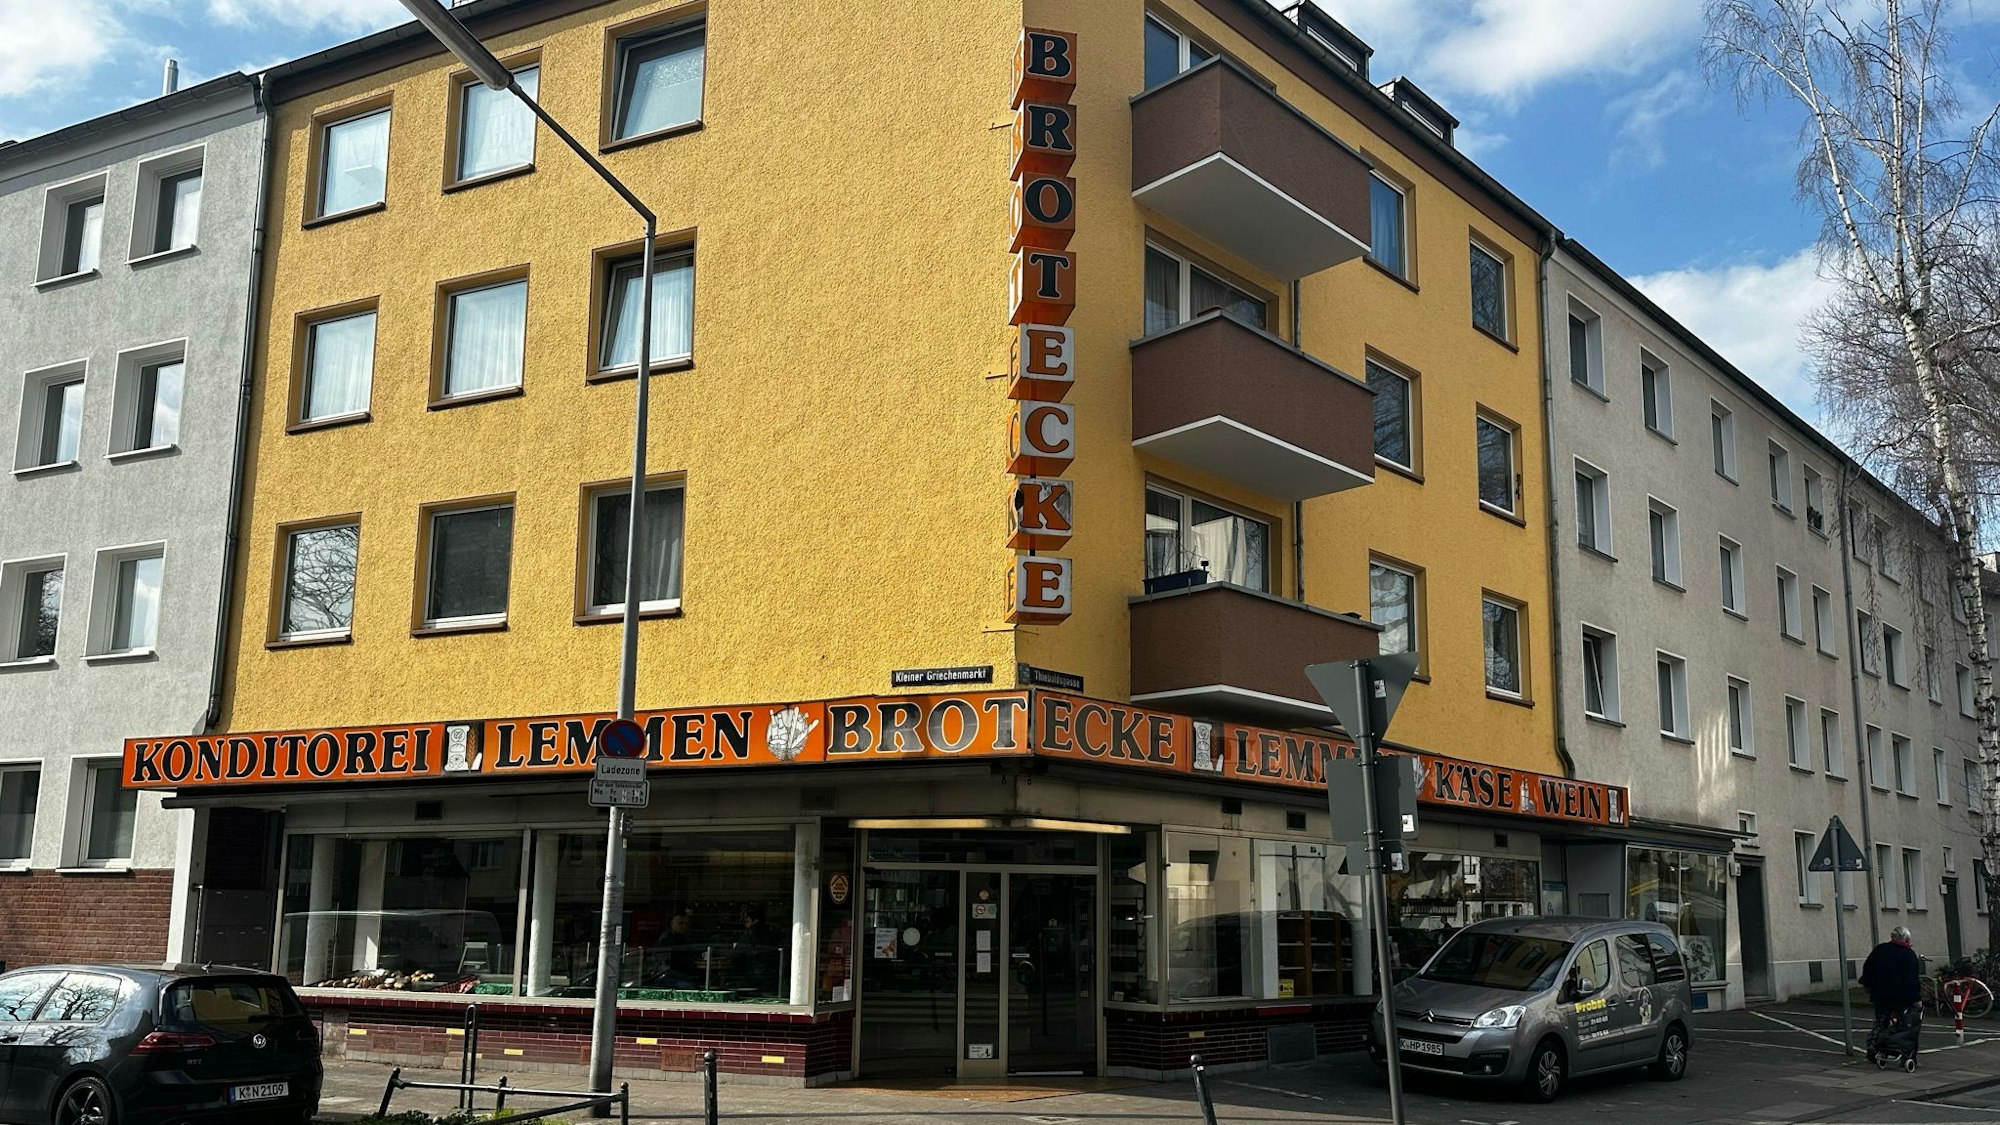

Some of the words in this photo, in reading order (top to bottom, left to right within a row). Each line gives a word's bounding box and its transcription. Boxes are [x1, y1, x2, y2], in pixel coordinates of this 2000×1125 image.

[895, 672, 924, 683] Kleiner
[926, 668, 987, 681] Griechenmarkt
[826, 697, 1028, 754] BROT
[1041, 697, 1176, 764] ECKE
[132, 728, 431, 783] KONDITOREI
[601, 764, 640, 775] Ladezone
[1434, 760, 1514, 809] KÄSE
[1539, 778, 1601, 820] WEIN
[261, 1084, 284, 1096] 2109
